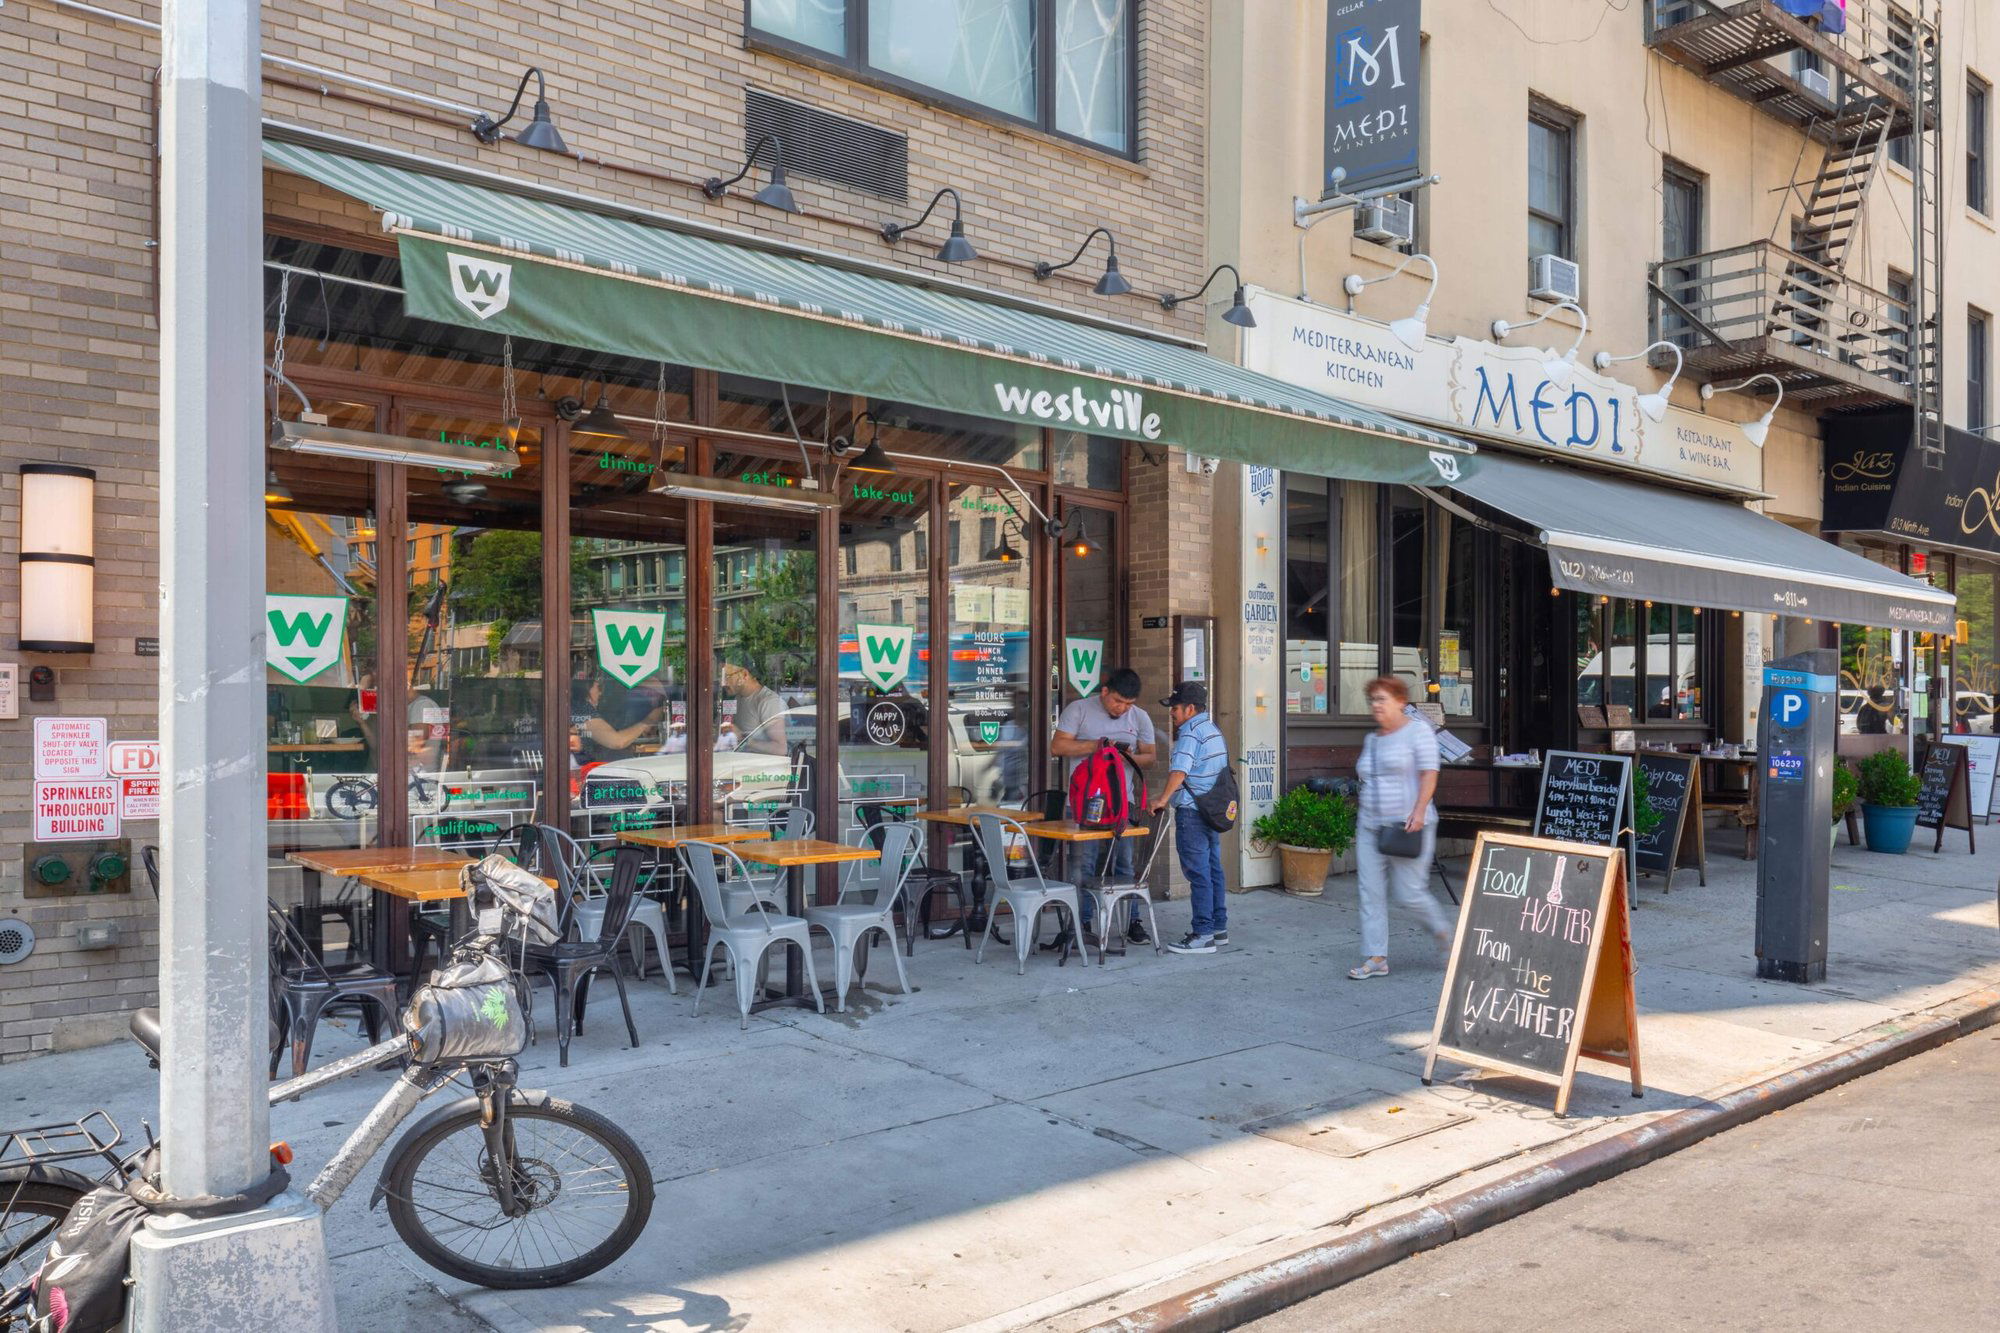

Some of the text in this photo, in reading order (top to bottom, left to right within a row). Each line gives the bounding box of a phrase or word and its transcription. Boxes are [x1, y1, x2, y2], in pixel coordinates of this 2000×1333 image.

[1336, 0, 1364, 16] CELLAR
[1348, 25, 1406, 89] M
[1333, 104, 1408, 146] MEDI
[458, 265, 503, 297] W
[1292, 326, 1414, 371] MEDITERRANEAN
[1326, 361, 1384, 388] KITCHEN
[1471, 365, 1624, 453] MEDI
[1676, 426, 1732, 453] RESTAURANT
[600, 451, 655, 474] dinner
[1688, 450, 1711, 466] WINE
[1712, 456, 1731, 472] BAR
[742, 471, 791, 488] eat-in
[1251, 467, 1274, 493] HOUR
[1835, 482, 1892, 493] Indian Cuisine
[853, 484, 916, 504] take-out
[1903, 518, 1918, 533] Ninth
[1247, 590, 1275, 600] OUTDOOR
[1244, 602, 1278, 623] GARDEN
[267, 609, 333, 648] W
[605, 623, 655, 657] W
[974, 632, 1005, 643] HOURS
[866, 635, 905, 665] W
[979, 647, 1001, 655] LUNCH
[1072, 647, 1098, 674] W
[977, 667, 1004, 675] DINNER
[975, 691, 1004, 700] BRUNCH
[1460, 687, 1470, 707] A
[873, 711, 898, 721] HAPPY
[1783, 694, 1802, 722] P
[51, 723, 91, 731] AUTOMATIC
[870, 723, 901, 738] HOUR
[43, 740, 98, 748] SHUT-OFF VALVE
[42, 749, 73, 757] LOCATED
[44, 757, 97, 766] OPPOSITE THIS
[1247, 750, 1276, 766] PRIVATE
[63, 766, 81, 774] SIGN
[1771, 759, 1802, 768] 106239
[742, 771, 800, 783] mushrooms
[1249, 767, 1274, 784] DINING
[42, 786, 113, 801] SPRINKLERS
[128, 787, 149, 795] FIRE
[593, 785, 664, 801] artichokes
[1250, 784, 1273, 801] ROOM
[40, 802, 116, 817] THROUGHOUT
[609, 811, 657, 822] rainbow
[1545, 806, 1573, 818] Lunch
[50, 818, 105, 833] BUILDING
[424, 820, 500, 838] cauliflower
[1544, 823, 1572, 837] Brunch
[1482, 848, 1531, 897] Food
[1519, 897, 1592, 946] HOTTER
[1473, 927, 1511, 962] Than
[1511, 957, 1552, 994] the
[1463, 980, 1575, 1044] WEATHER
